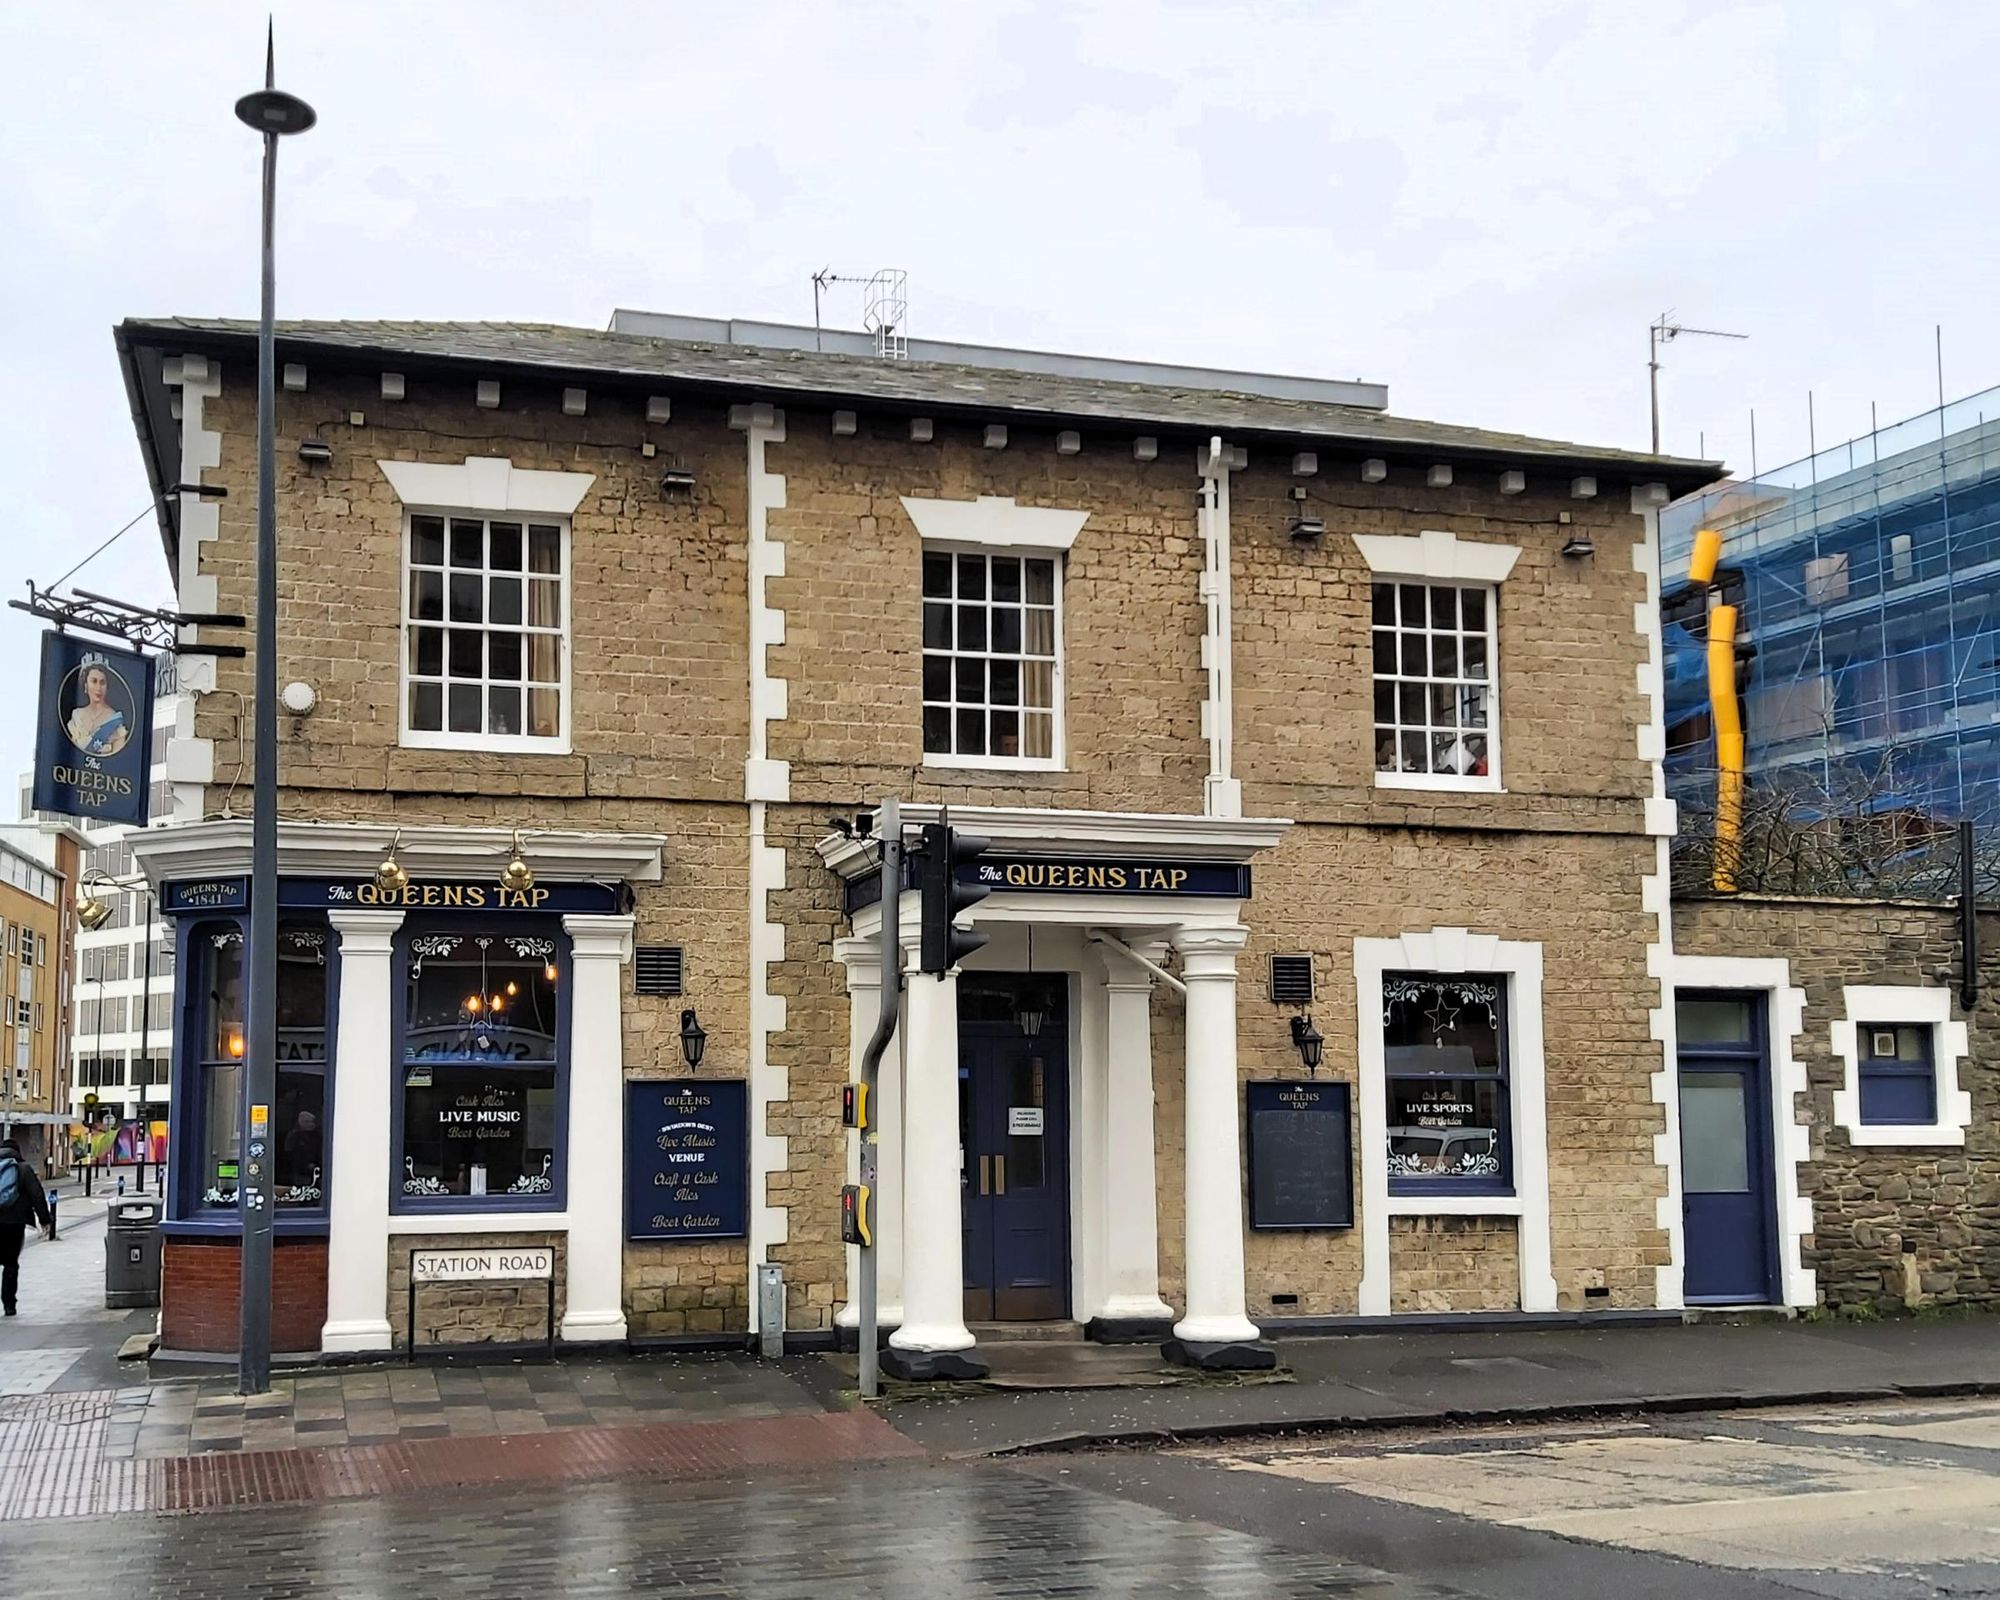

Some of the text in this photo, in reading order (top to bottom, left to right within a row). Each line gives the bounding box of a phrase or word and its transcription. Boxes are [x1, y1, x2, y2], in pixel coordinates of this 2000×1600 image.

[84, 756, 101, 770] The
[52, 765, 132, 795] QUEENS
[76, 789, 107, 807] TAP
[979, 864, 1188, 889] The QUEENS TAP
[180, 883, 237, 899] QUEENS TAP
[328, 883, 550, 908] The QUEENS TAP
[194, 894, 222, 905] 1841
[663, 1096, 711, 1106] QUEENS
[1279, 1092, 1320, 1101] QUEENS
[678, 1106, 697, 1114] TAP
[1291, 1101, 1308, 1109] TAP
[1406, 1103, 1473, 1113] LIVE SPORTS
[439, 1111, 521, 1122] LIVE MUSIC
[447, 1126, 511, 1139] Beer Garden
[656, 1134, 717, 1150] Live Music
[669, 1153, 705, 1163] VENUE
[654, 1172, 679, 1188] Craft
[694, 1171, 718, 1184] Cask
[673, 1188, 698, 1201] Ales
[651, 1213, 720, 1229] Beer Garden
[417, 1255, 547, 1273] STATION ROAD
